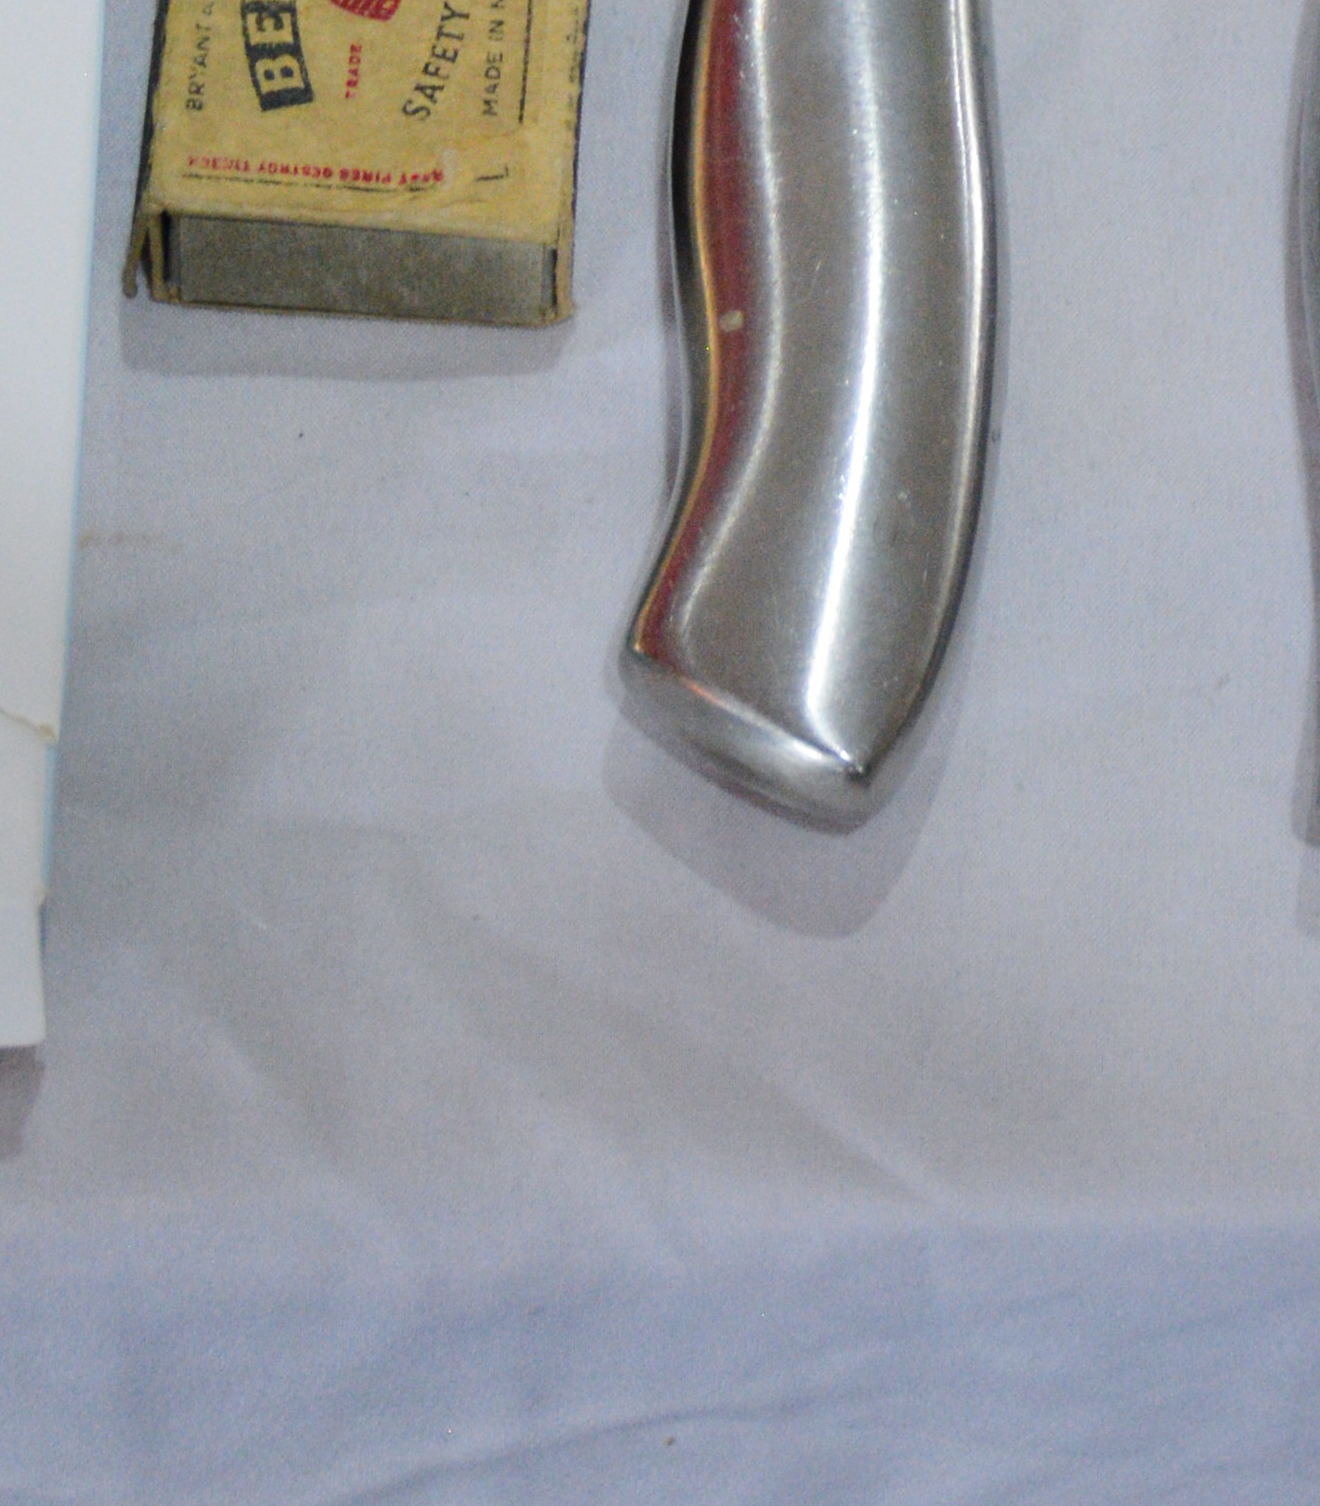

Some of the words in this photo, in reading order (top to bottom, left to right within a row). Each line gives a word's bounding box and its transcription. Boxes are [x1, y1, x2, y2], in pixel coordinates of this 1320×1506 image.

[401, 0, 471, 123] SAFETY
[488, 18, 505, 43] IN
[185, 22, 210, 112] BRYANT
[344, 42, 363, 101] TRADE
[482, 50, 504, 117] MADE
